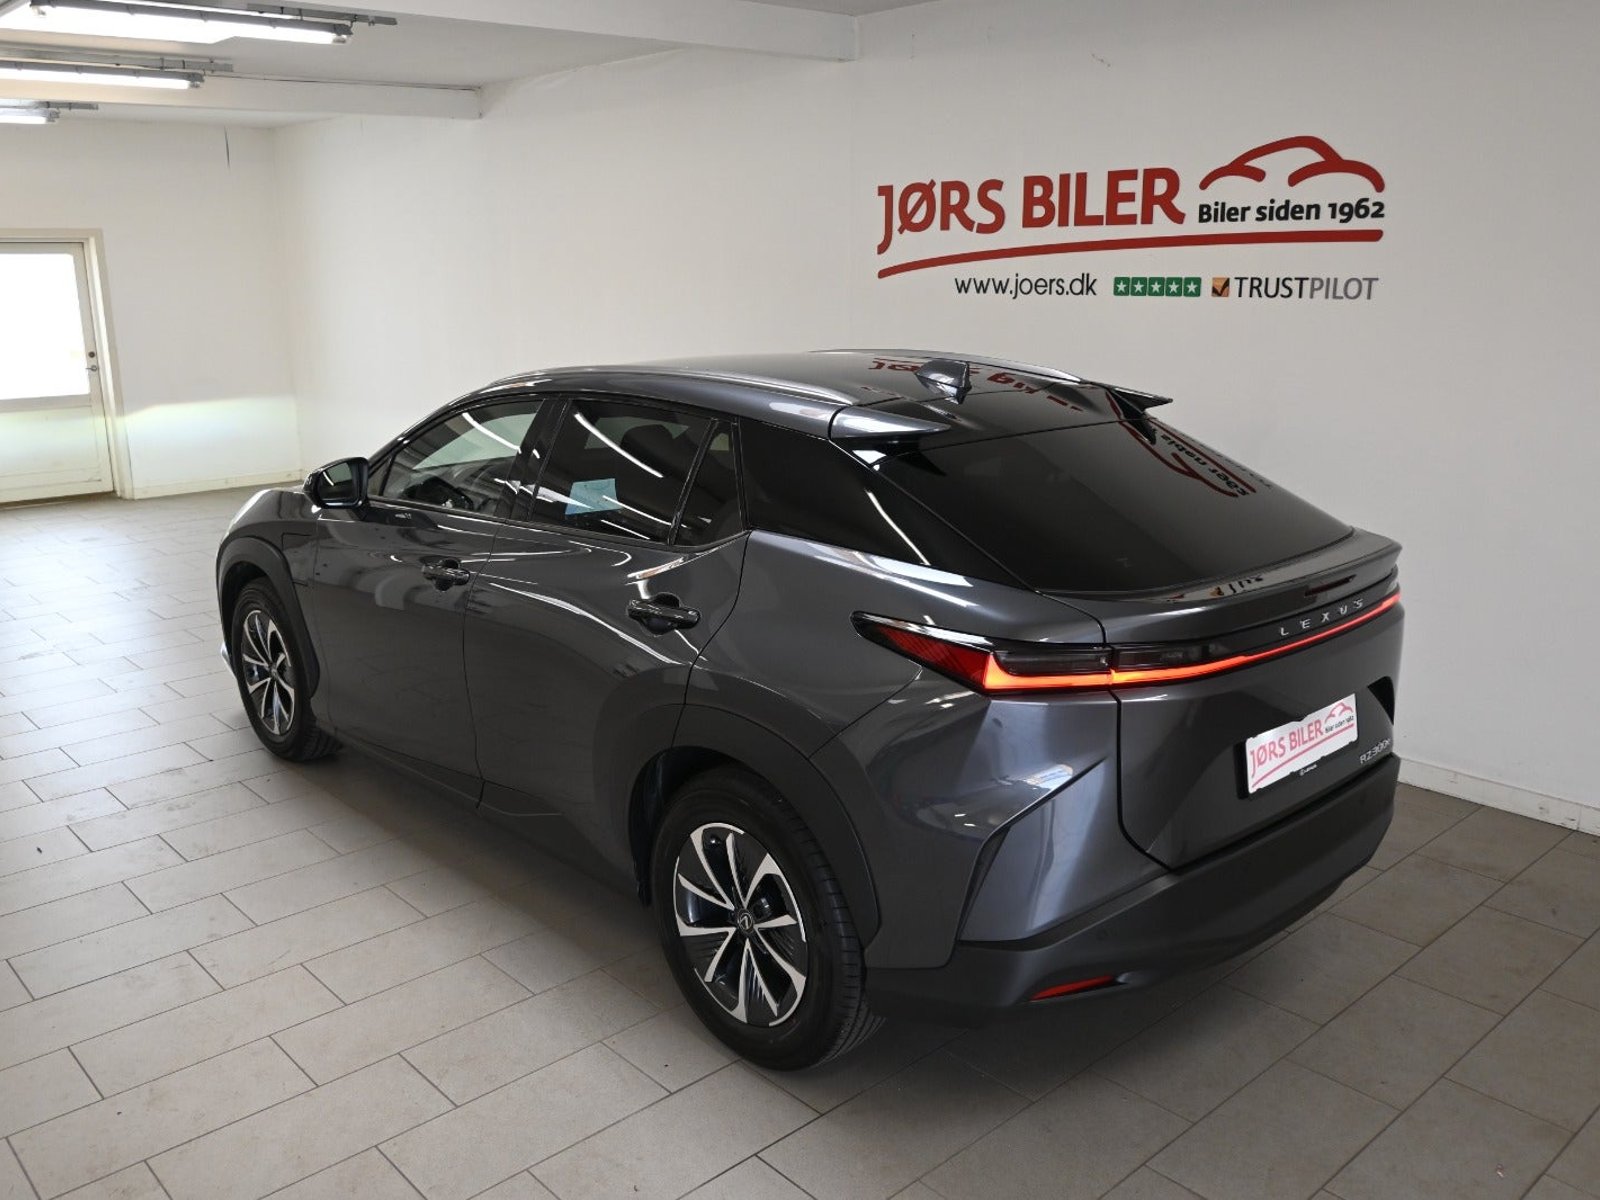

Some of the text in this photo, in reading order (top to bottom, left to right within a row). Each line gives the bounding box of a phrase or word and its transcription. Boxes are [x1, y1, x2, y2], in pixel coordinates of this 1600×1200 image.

[877, 167, 1186, 255] JØRS BILER
[1198, 198, 1385, 223] Biler siden 1962
[954, 272, 1098, 300] www.joers.dk
[1234, 276, 1379, 300] TRUSTPILOT
[1280, 599, 1363, 636] LEXUS
[1250, 719, 1324, 778] JØRS BILER
